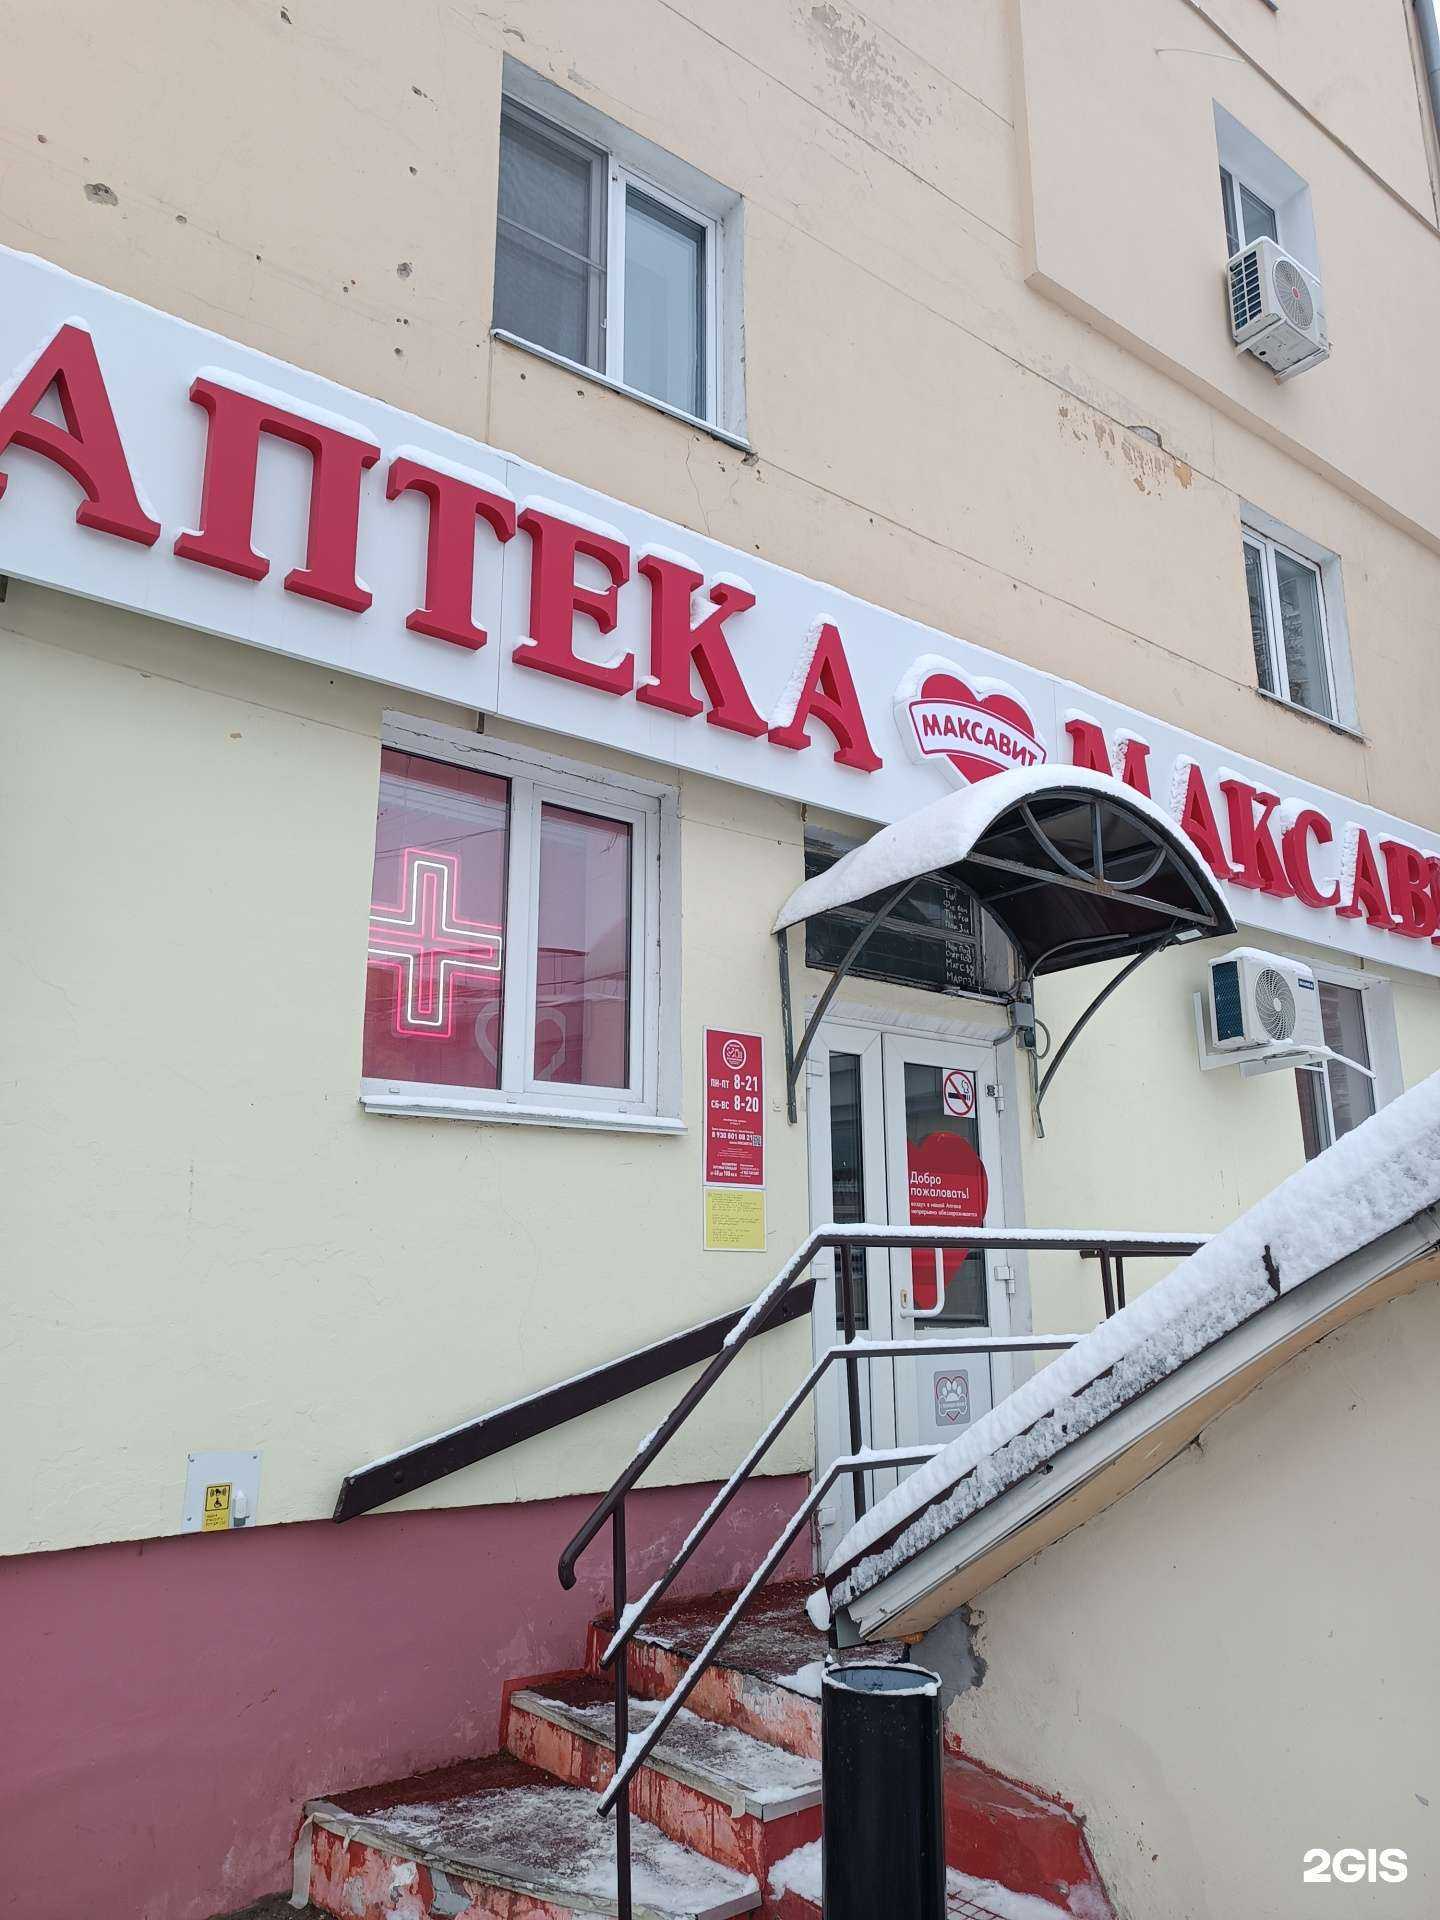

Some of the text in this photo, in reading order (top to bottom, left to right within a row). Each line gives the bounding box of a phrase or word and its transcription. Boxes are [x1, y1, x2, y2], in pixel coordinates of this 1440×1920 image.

[0, 323, 883, 773] АПТЕКА
[922, 713, 1038, 767] МАКСАВИТ
[733, 1073, 759, 1092] 8-21
[733, 1094, 759, 1113] 8-20
[910, 1171, 942, 1187] Добро
[910, 1187, 970, 1200] пожаловать!
